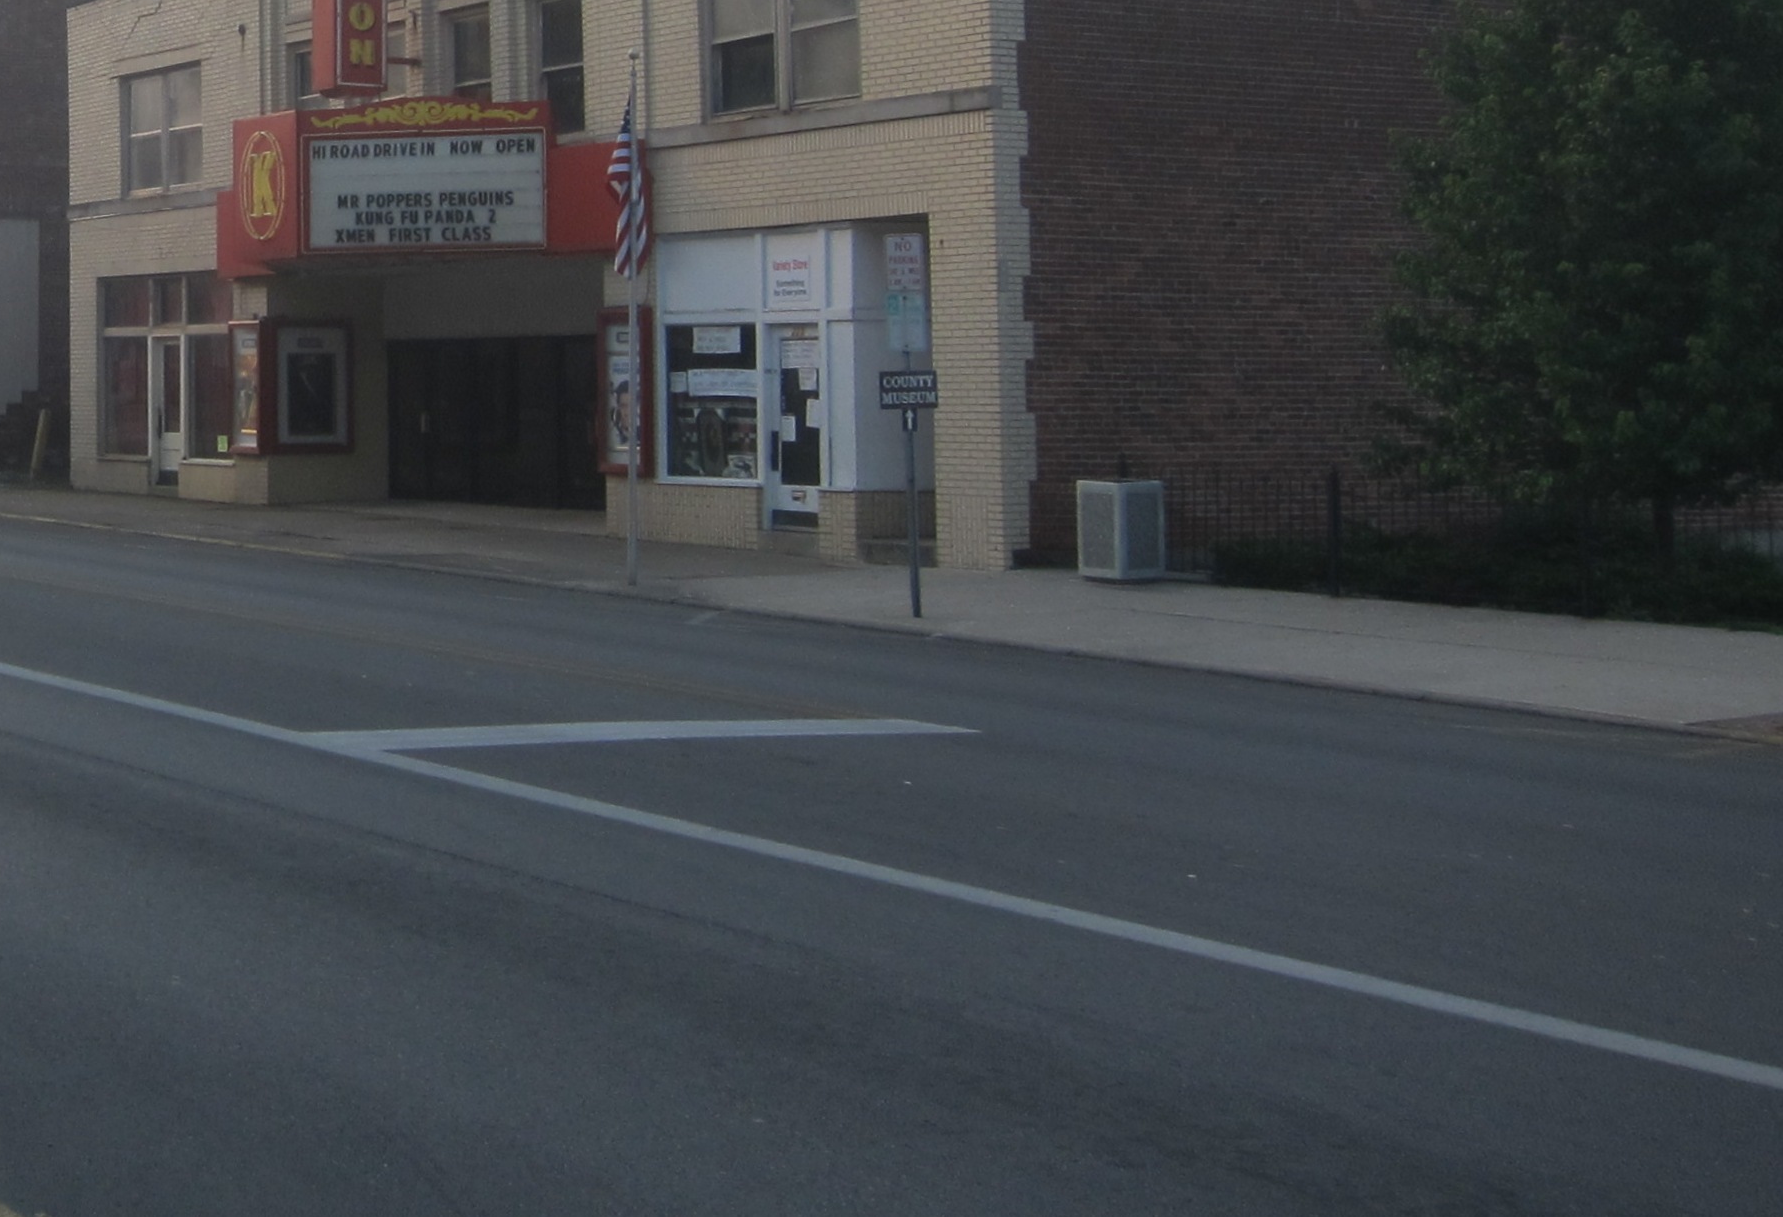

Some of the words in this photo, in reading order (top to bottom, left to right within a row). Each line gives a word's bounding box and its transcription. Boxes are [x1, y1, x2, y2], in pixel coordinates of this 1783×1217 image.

[311, 145, 326, 160] HI
[329, 144, 370, 159] ROAD
[449, 140, 483, 155] NOW
[495, 138, 535, 153] OPEN
[249, 151, 278, 217] K
[337, 194, 359, 209] MR
[366, 192, 432, 208] POPPERS
[439, 190, 514, 207] PENGUINS
[355, 211, 394, 226] KUNG
[401, 210, 418, 225] FU
[424, 209, 475, 224] PANDA
[488, 209, 497, 223] 2
[335, 228, 375, 243] XMEN
[389, 227, 431, 243] FIRST
[441, 226, 492, 242] CLASS
[894, 241, 912, 252] NO
[883, 375, 934, 389] COUNTY
[881, 391, 936, 405] MUSEUM
